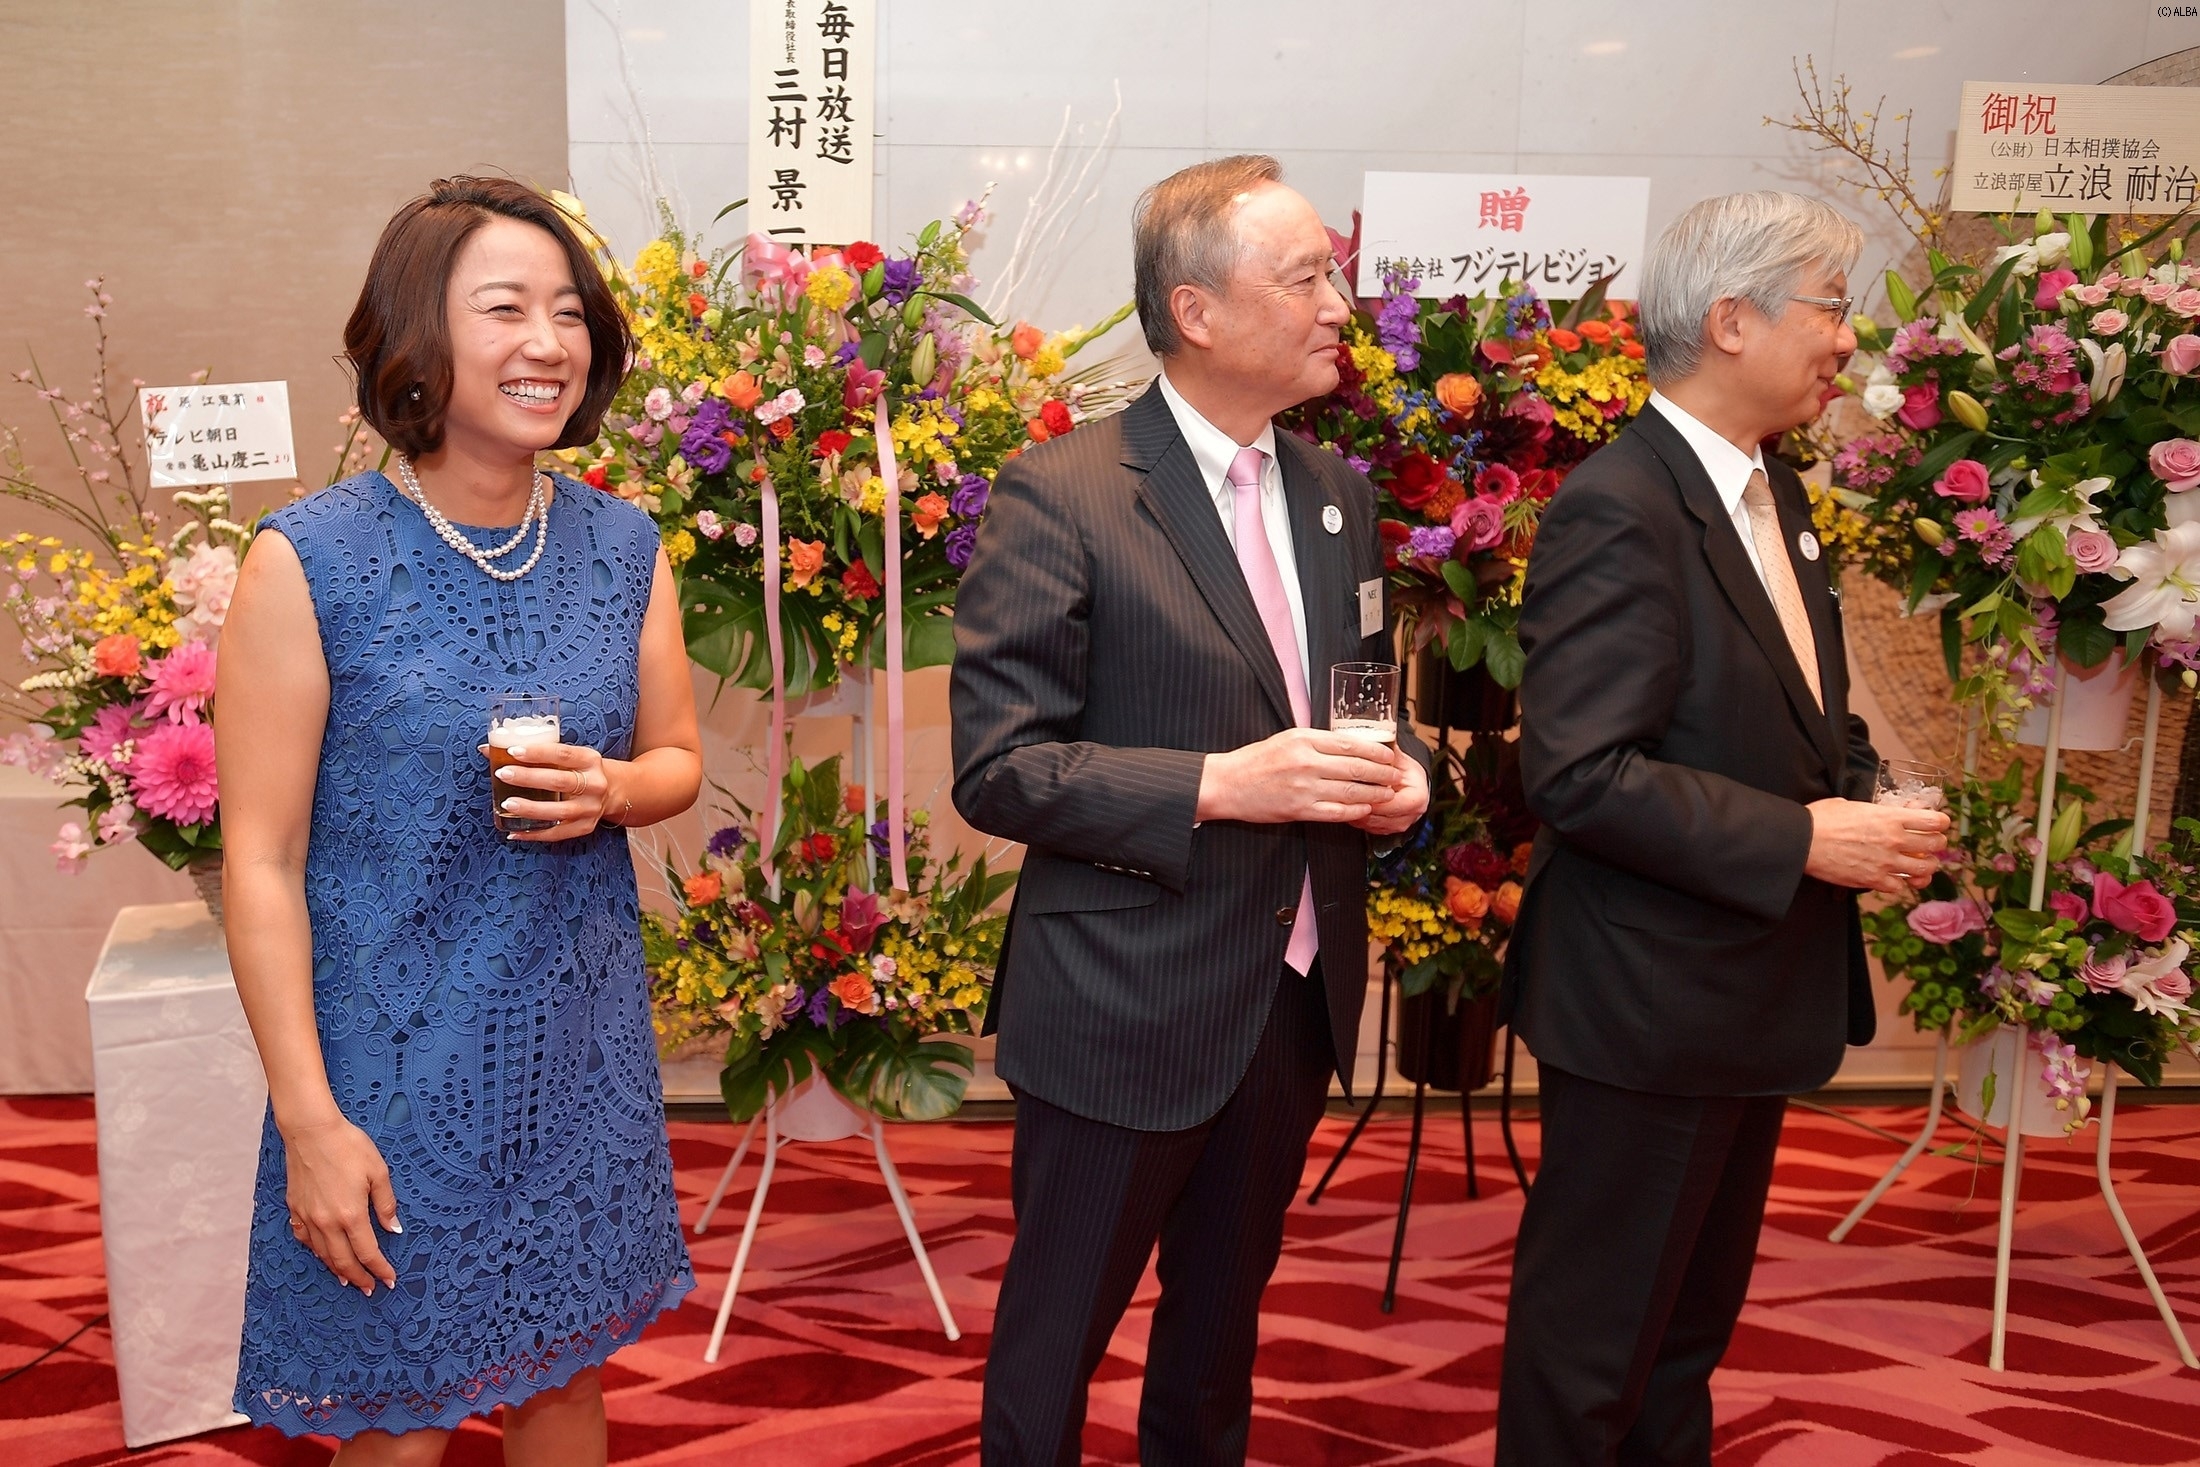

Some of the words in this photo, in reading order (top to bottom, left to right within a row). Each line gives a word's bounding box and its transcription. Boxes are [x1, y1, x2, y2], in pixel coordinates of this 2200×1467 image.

[816, 0, 855, 164] 毎日放送
[767, 69, 808, 150] 三村
[1981, 92, 2057, 135] 御祝
[2043, 137, 2161, 160] 日本相撲協会
[768, 168, 807, 235] 景一
[1973, 172, 2043, 192] 立浪部屋
[2041, 163, 2113, 201] 立浪
[2126, 164, 2199, 203] 耐治
[1478, 186, 1531, 232] 贈
[1451, 247, 1627, 285] フジテレビジョン
[156, 427, 237, 446] テレビ朝日
[191, 452, 270, 472] 亀山慶二
